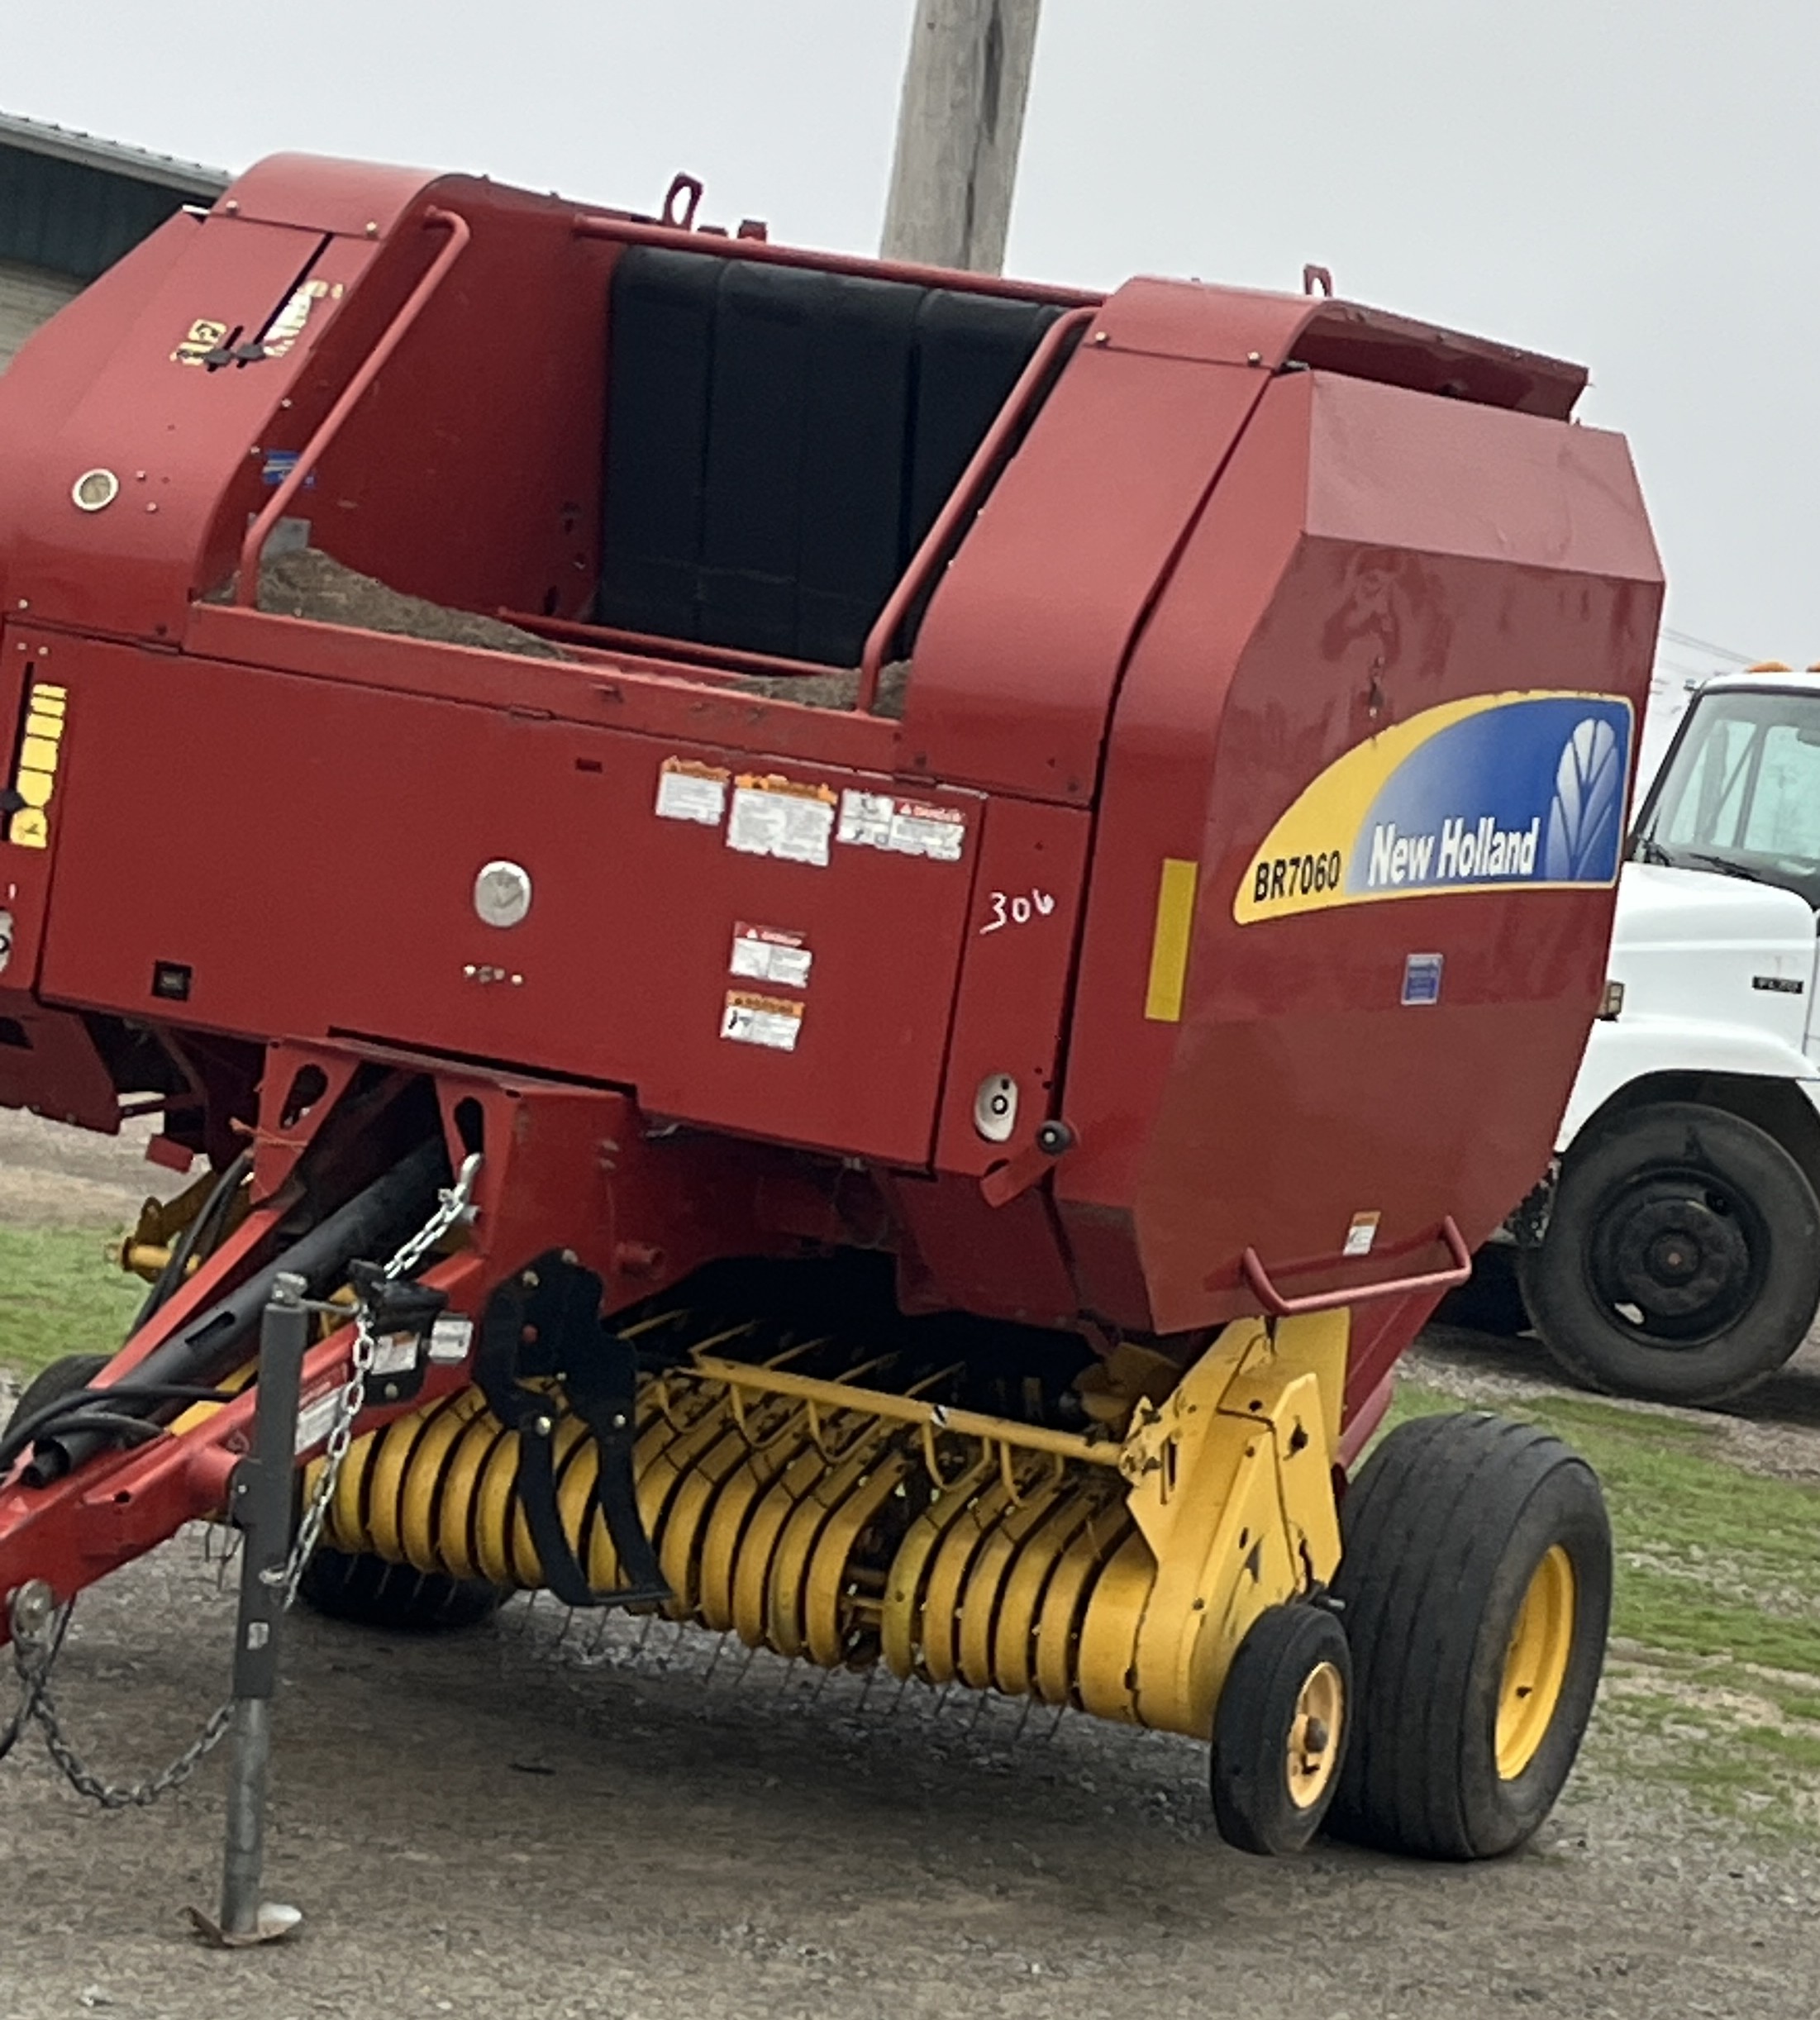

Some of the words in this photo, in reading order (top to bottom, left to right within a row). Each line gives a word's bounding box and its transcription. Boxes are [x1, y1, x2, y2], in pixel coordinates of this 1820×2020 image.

[1254, 850, 1341, 903] BR7060
[1368, 824, 1434, 886] New
[1436, 817, 1541, 879] Holland
[979, 889, 1055, 935] 306
